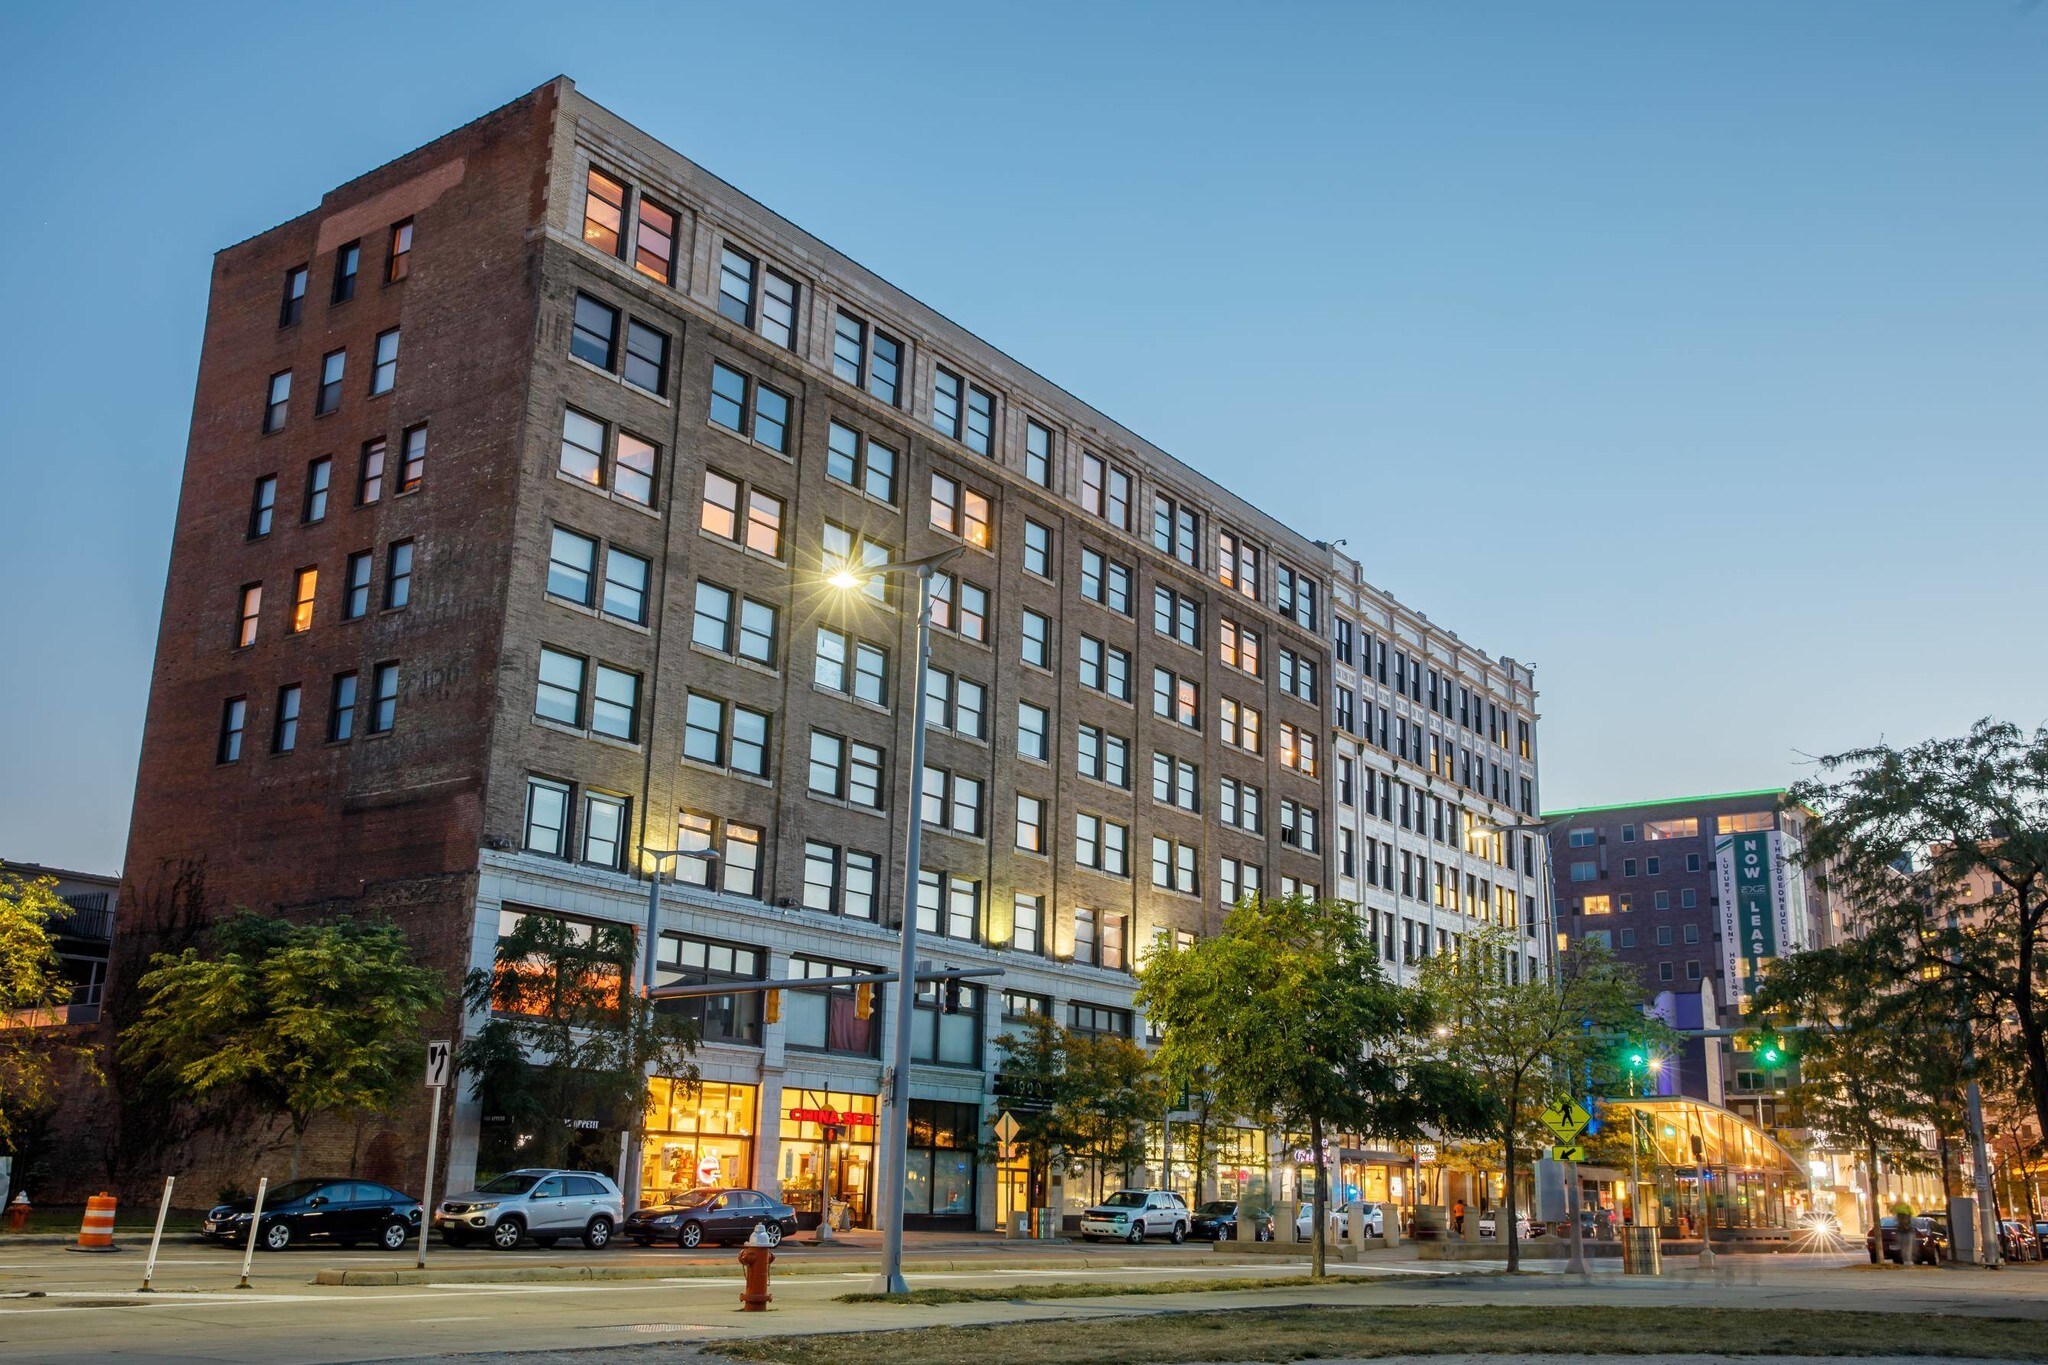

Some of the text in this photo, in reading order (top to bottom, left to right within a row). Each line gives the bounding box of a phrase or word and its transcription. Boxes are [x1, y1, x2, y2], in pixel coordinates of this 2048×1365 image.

[1744, 840, 1760, 879] NOW
[1726, 900, 1734, 943] STUDENT
[1729, 953, 1738, 996] HOUSING
[789, 1107, 873, 1126] CHINA SEA
